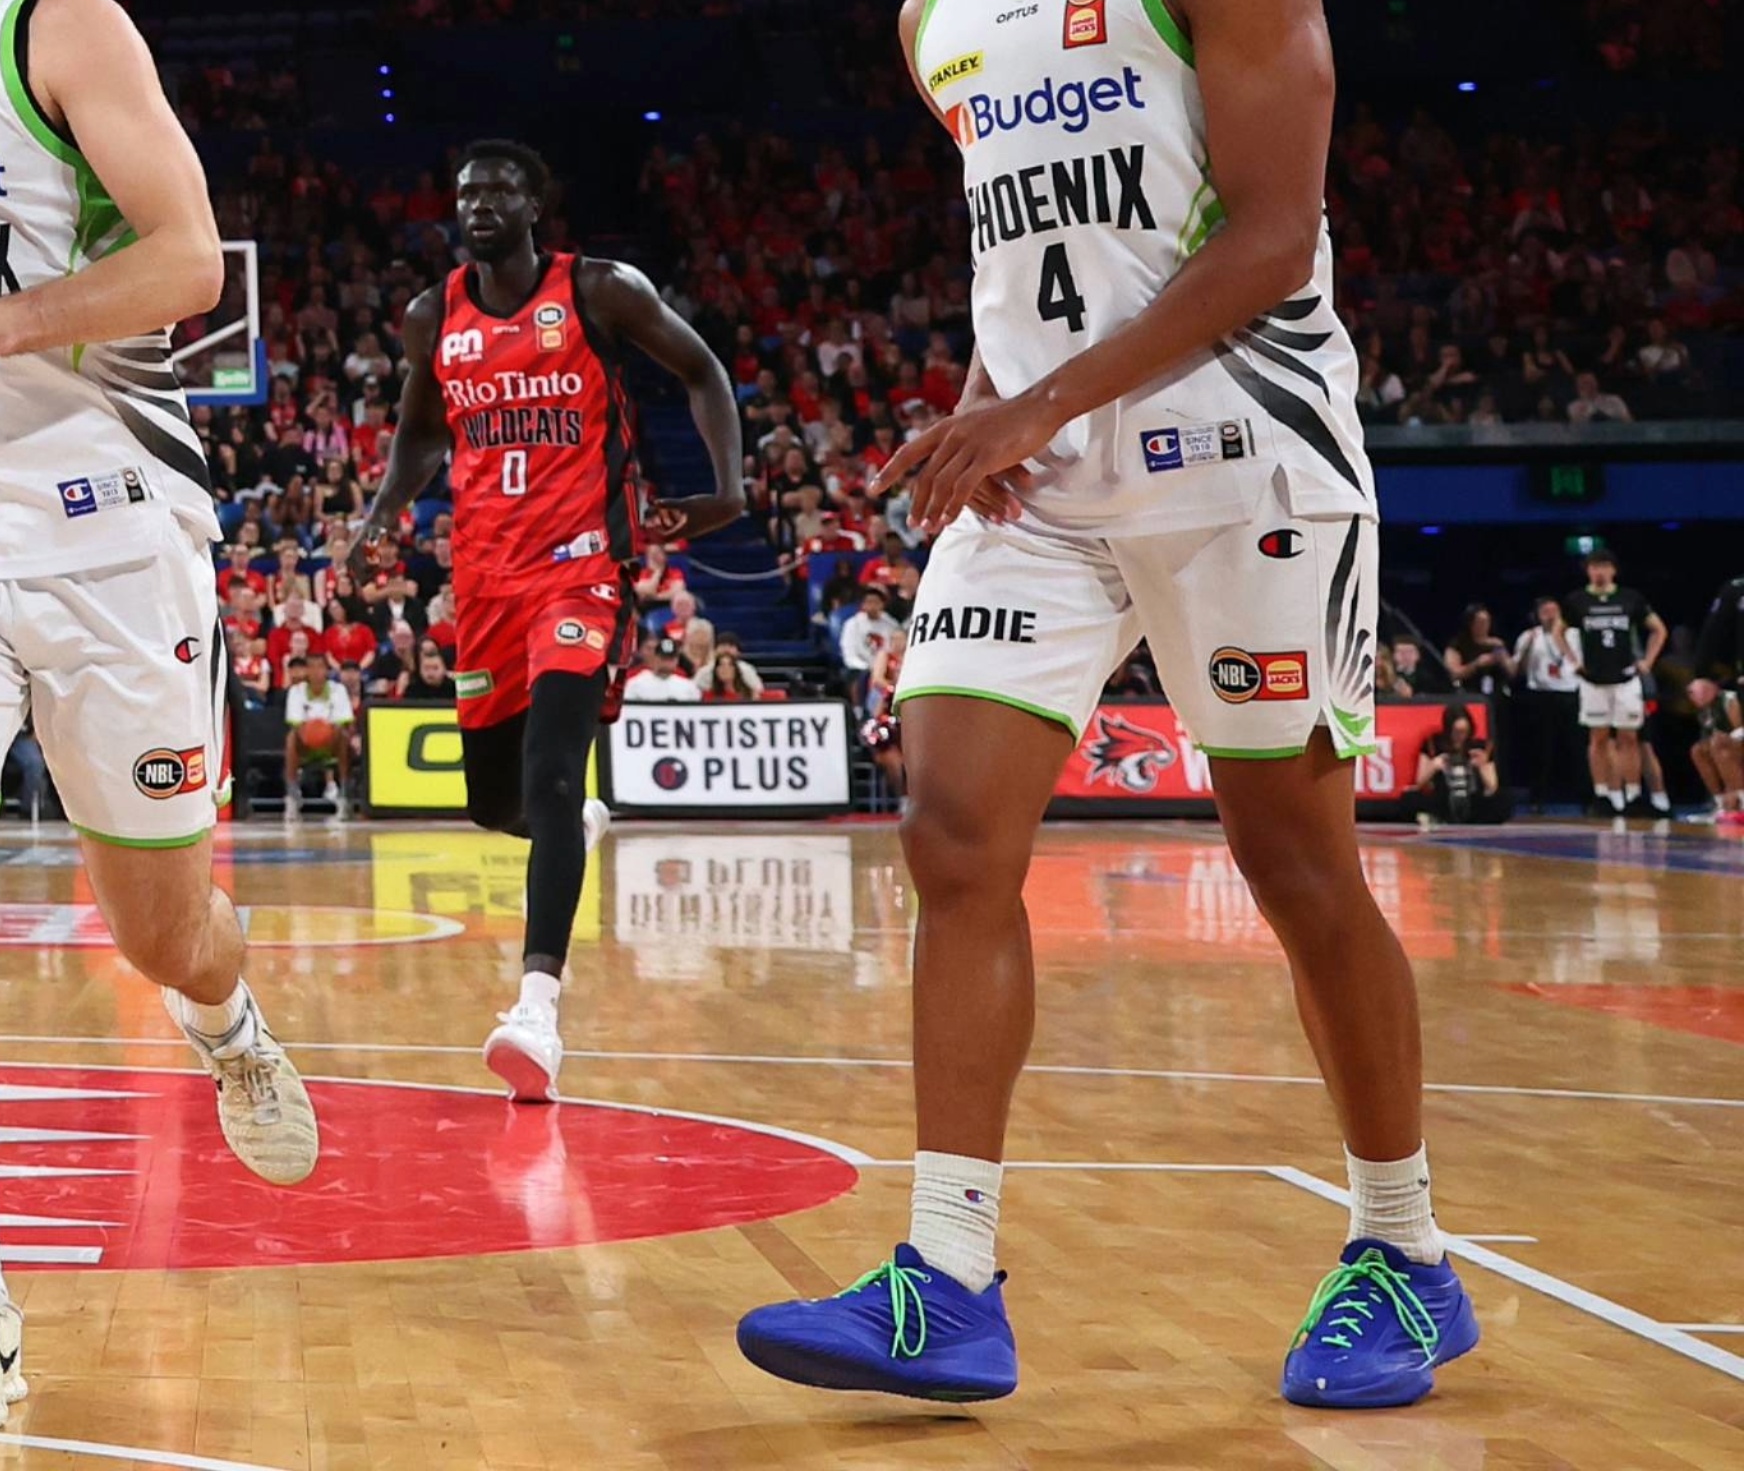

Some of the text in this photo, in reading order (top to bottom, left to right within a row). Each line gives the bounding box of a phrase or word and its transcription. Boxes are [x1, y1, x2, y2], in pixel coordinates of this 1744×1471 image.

[996, 4, 1038, 25] OPTUS
[969, 66, 1146, 139] Budget
[965, 144, 1157, 255] HOENIX
[1037, 242, 1086, 334] 4
[502, 449, 528, 497] 0
[910, 605, 1037, 647] RADIE
[1218, 663, 1250, 687] NBL
[625, 717, 830, 749] DENTISTRY
[145, 761, 176, 785] NBL
[704, 756, 811, 791] PLUS
